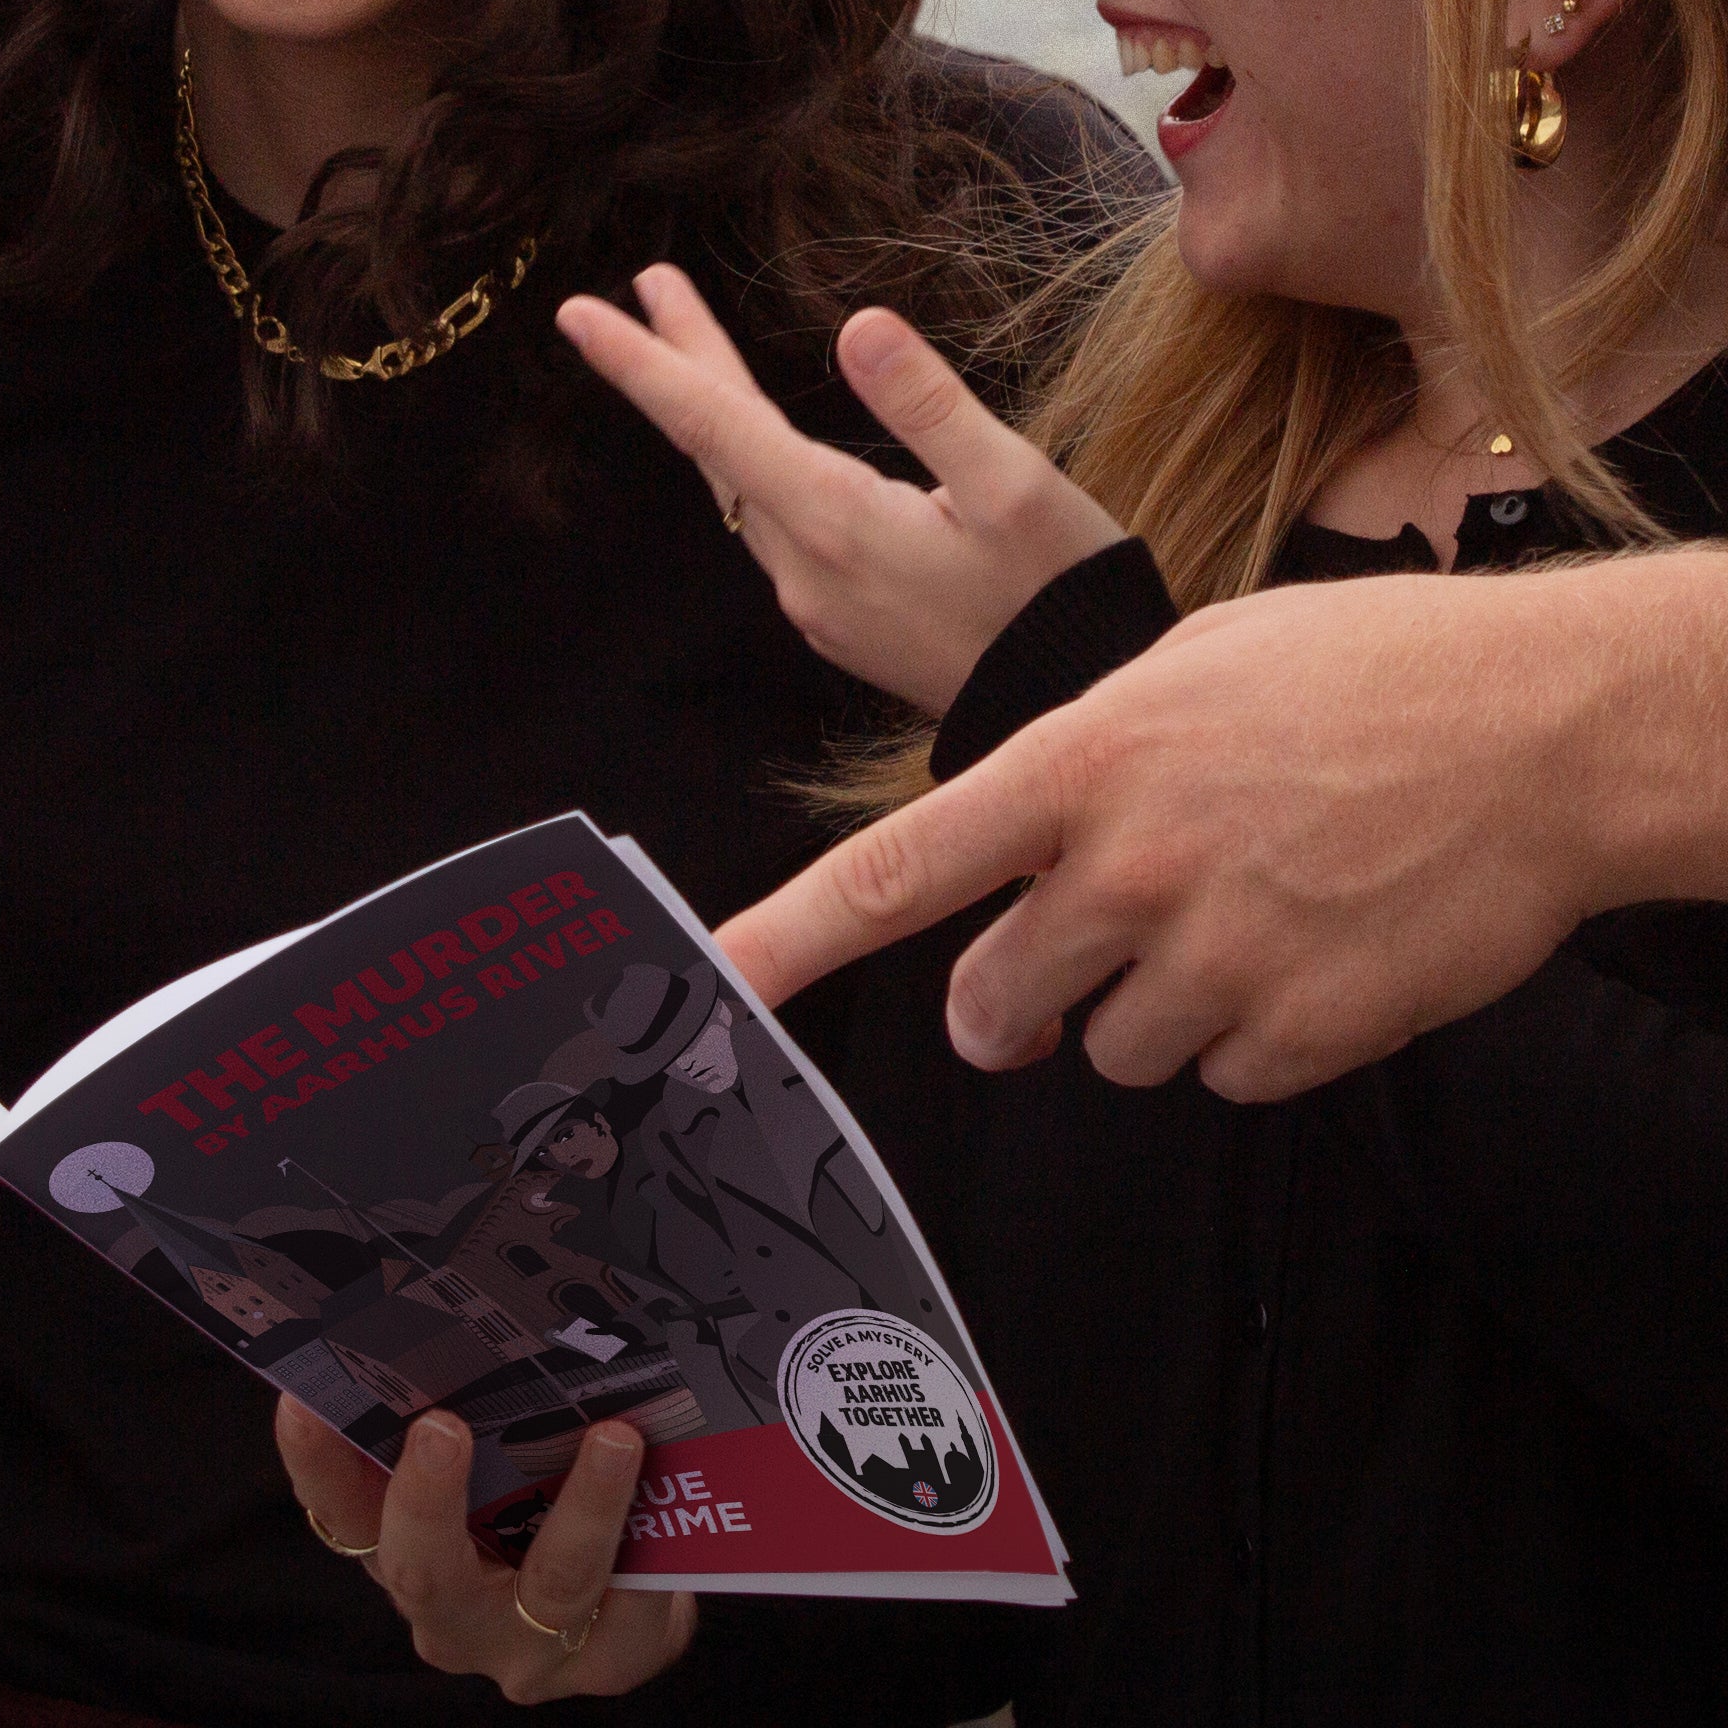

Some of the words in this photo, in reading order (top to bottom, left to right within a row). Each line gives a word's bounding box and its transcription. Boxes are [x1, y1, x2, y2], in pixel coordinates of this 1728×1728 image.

[137, 1024, 309, 1132] THE
[293, 870, 599, 1046] MURDER
[194, 1114, 250, 1156] BY
[263, 986, 478, 1125] AARHUS
[478, 909, 633, 1000] RIVER
[806, 1336, 845, 1374] SOLVE
[845, 1332, 857, 1345] A
[857, 1330, 934, 1368] MYSTERY
[826, 1359, 920, 1383] EXPLORE
[842, 1383, 926, 1404] AARHUS
[838, 1406, 945, 1428] TOGETHER
[620, 1501, 753, 1541] RIME
